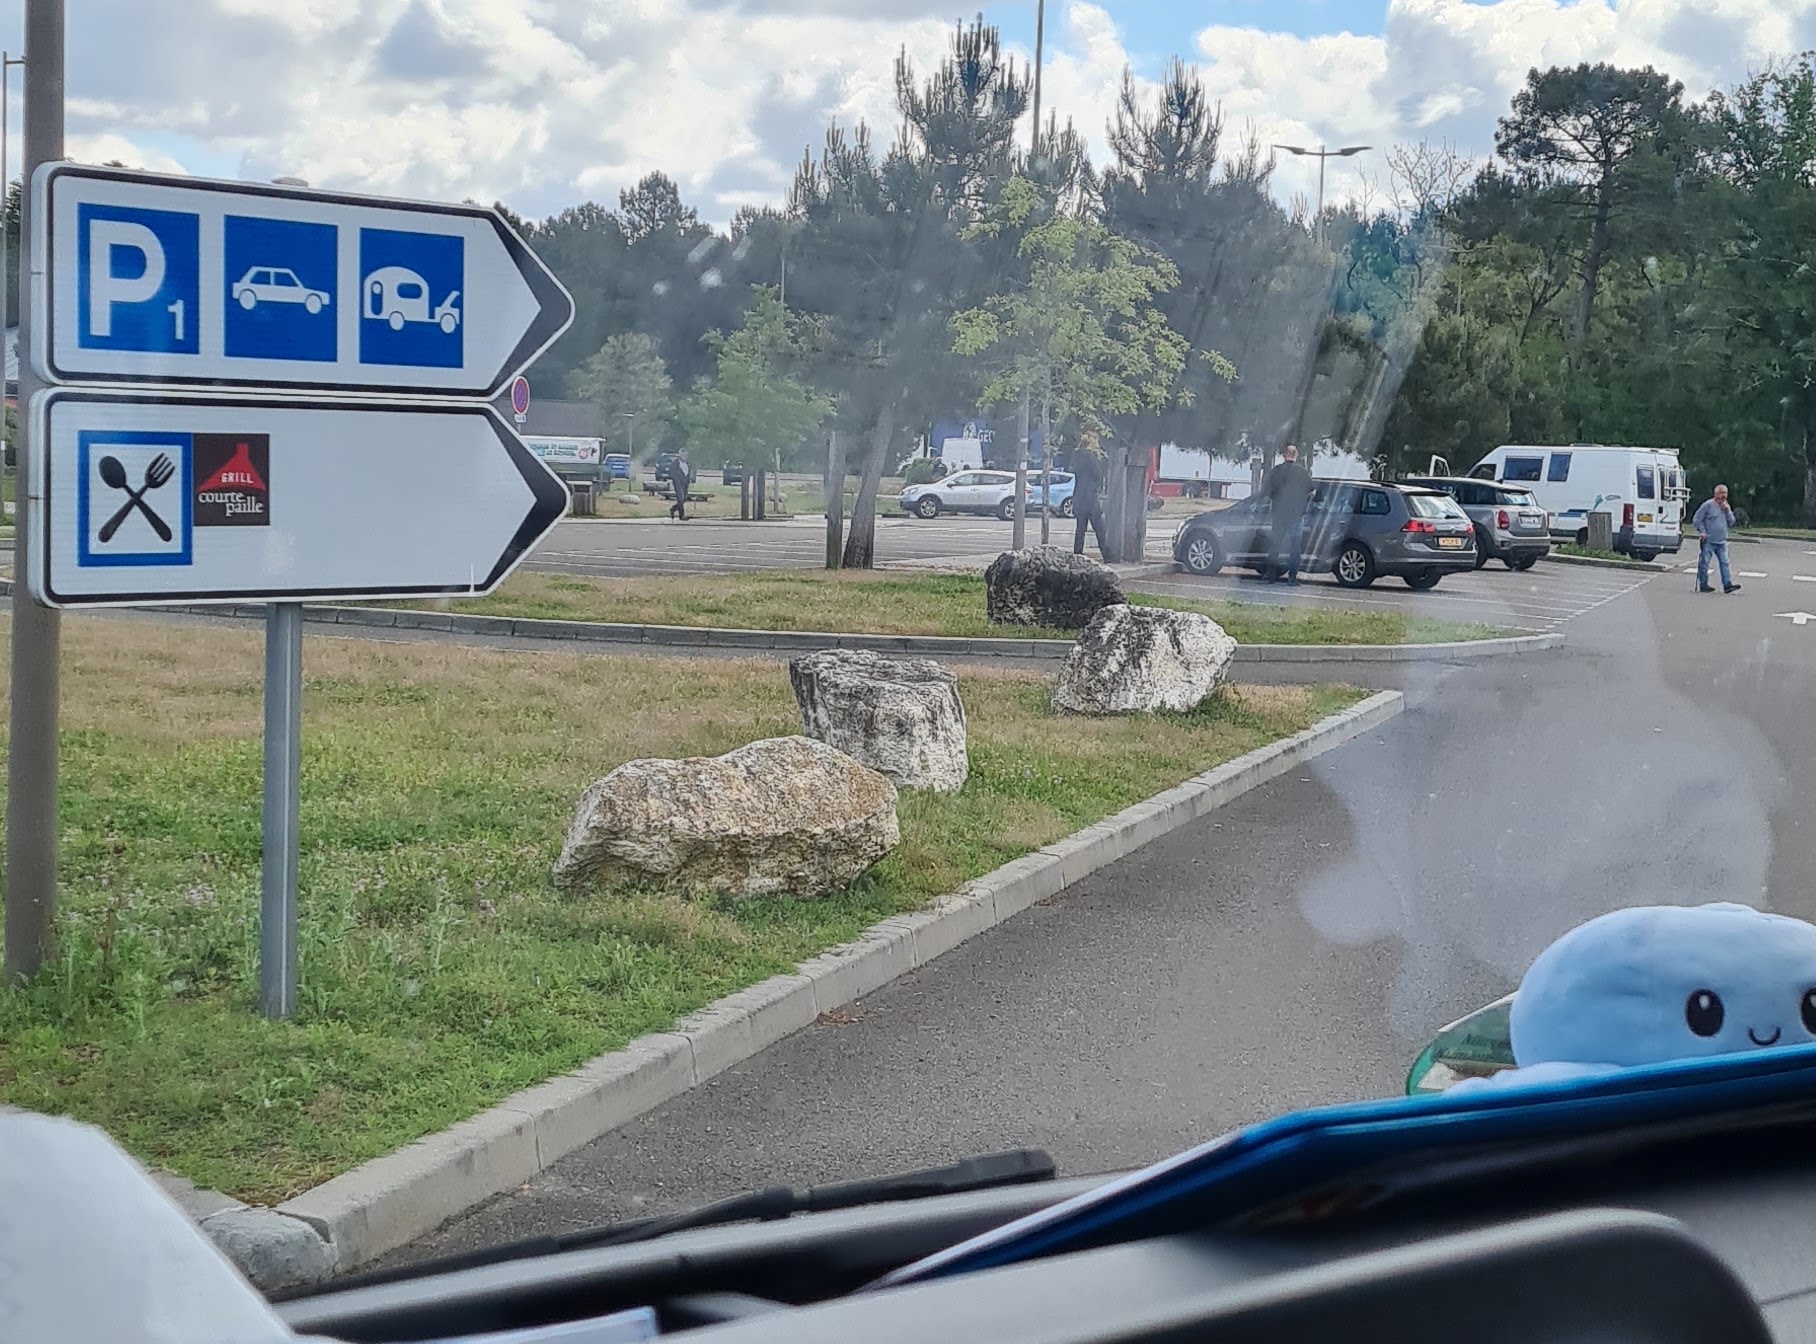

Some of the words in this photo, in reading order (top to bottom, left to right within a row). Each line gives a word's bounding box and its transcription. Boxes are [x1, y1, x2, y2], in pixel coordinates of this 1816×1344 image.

[221, 472, 254, 484] GRILL
[198, 492, 246, 503] courte
[225, 496, 264, 517] paille
